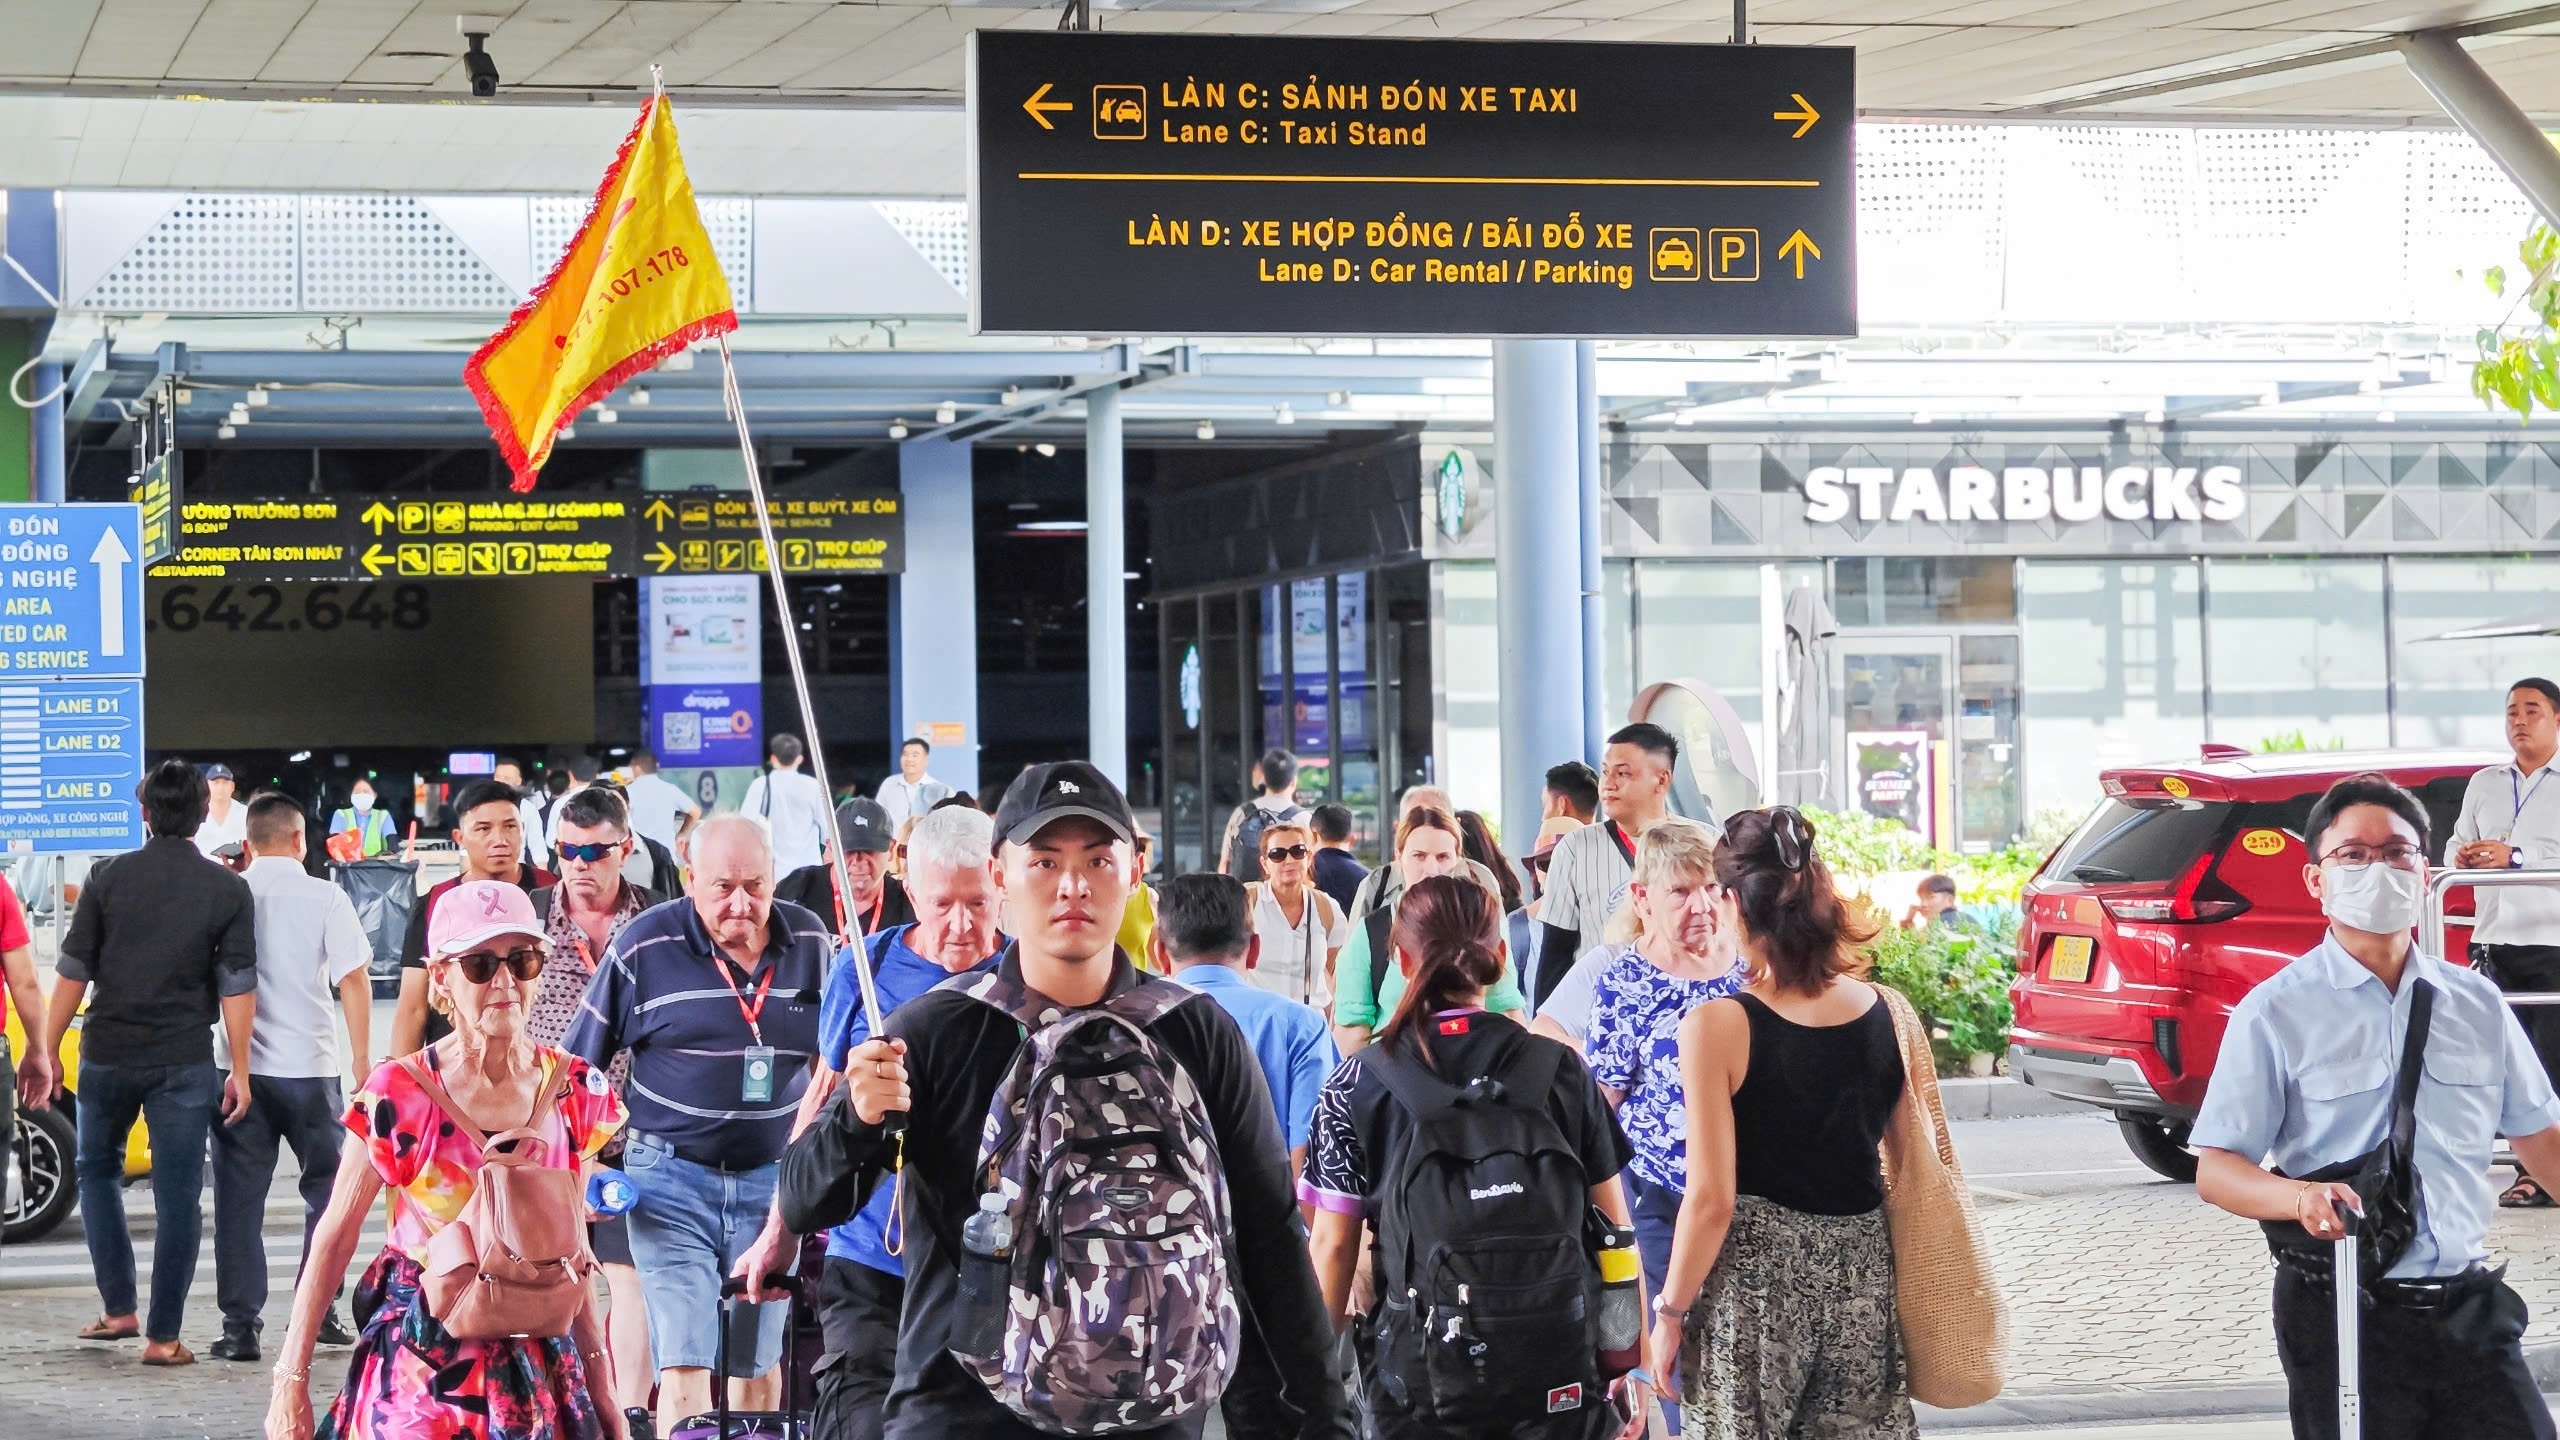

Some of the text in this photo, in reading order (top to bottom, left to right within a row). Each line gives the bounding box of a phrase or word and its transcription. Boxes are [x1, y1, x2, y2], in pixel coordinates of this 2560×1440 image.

[1162, 76, 1577, 113] LÀN C: SẢNH ĐÓN XE TAXI
[1163, 119, 1426, 146] Lane C: Taxi Stand
[1128, 210, 1633, 252] LÀN D: XE HỢP ĐỒNG / BÃI ĐỖ XE
[1259, 257, 1633, 290] Lane D: Car Rental / Parking
[1804, 465, 2247, 523] STARBUCKS
[8, 513, 60, 537] ĐÓN
[242, 545, 271, 561] TÂN
[272, 547, 304, 561] SƠN
[11, 566, 79, 591] NGHỆ
[5, 597, 53, 616] AREA
[32, 624, 68, 643] CAR
[15, 650, 90, 669] SERVICE
[45, 698, 119, 715] LANE D1
[45, 734, 121, 751] LANE D2
[45, 782, 112, 799] LANE D
[2245, 834, 2283, 849] 259
